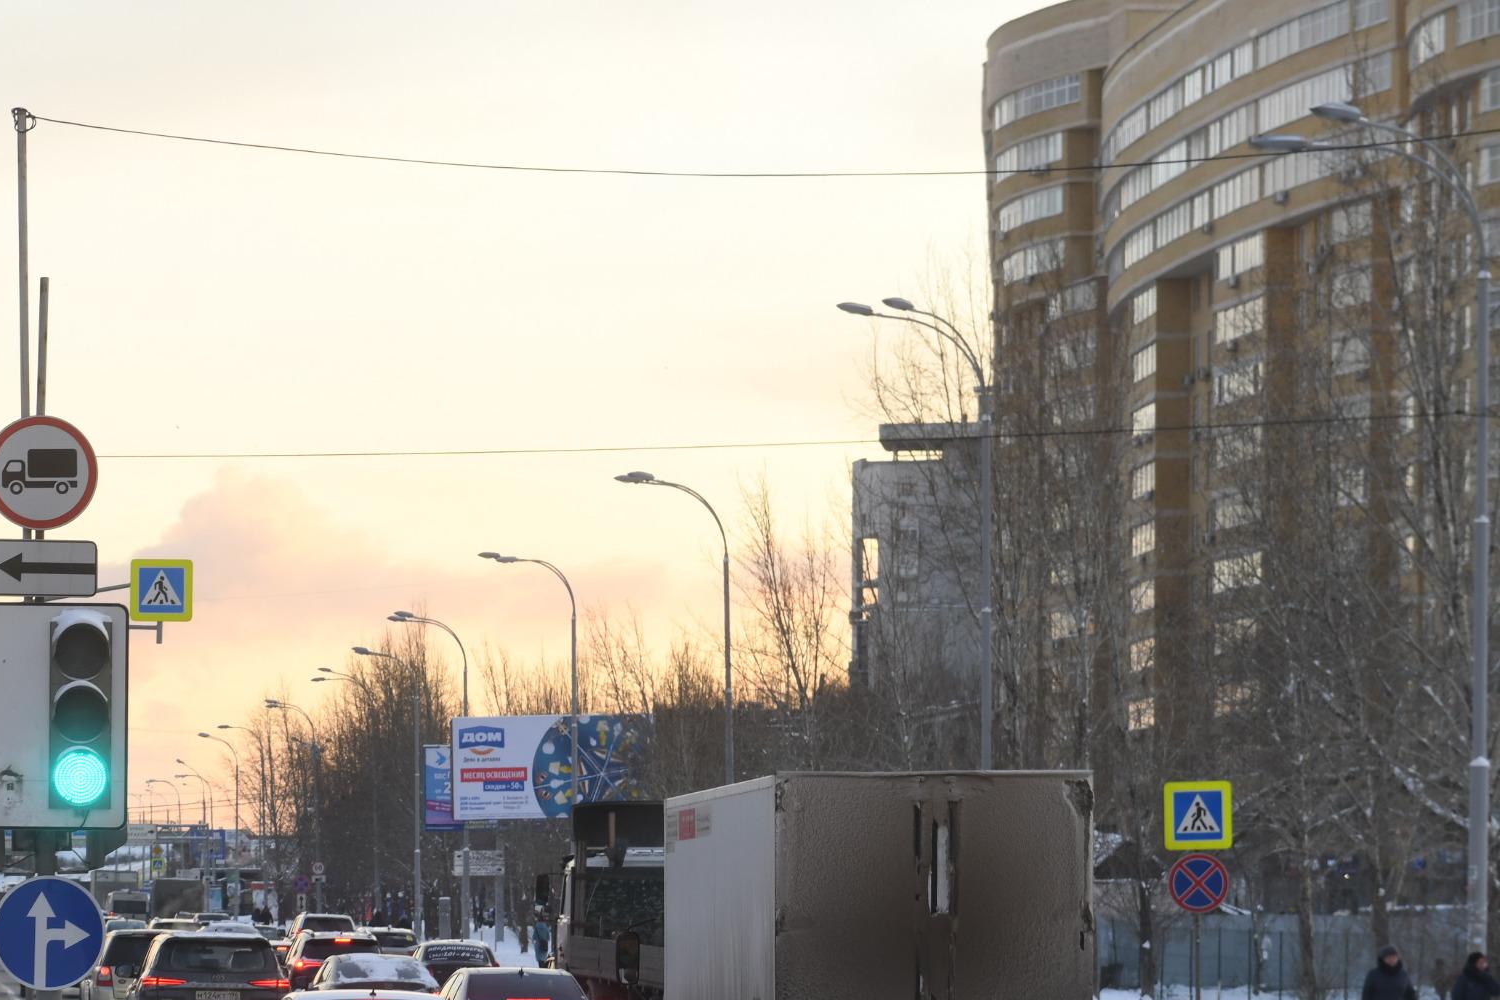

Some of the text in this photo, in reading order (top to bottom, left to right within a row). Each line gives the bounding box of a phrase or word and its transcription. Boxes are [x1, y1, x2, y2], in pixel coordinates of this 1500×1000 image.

[461, 732, 502, 744] ДОМ
[463, 771, 525, 780] МЕСЯЦ ОСВЕЩЕНИЯ
